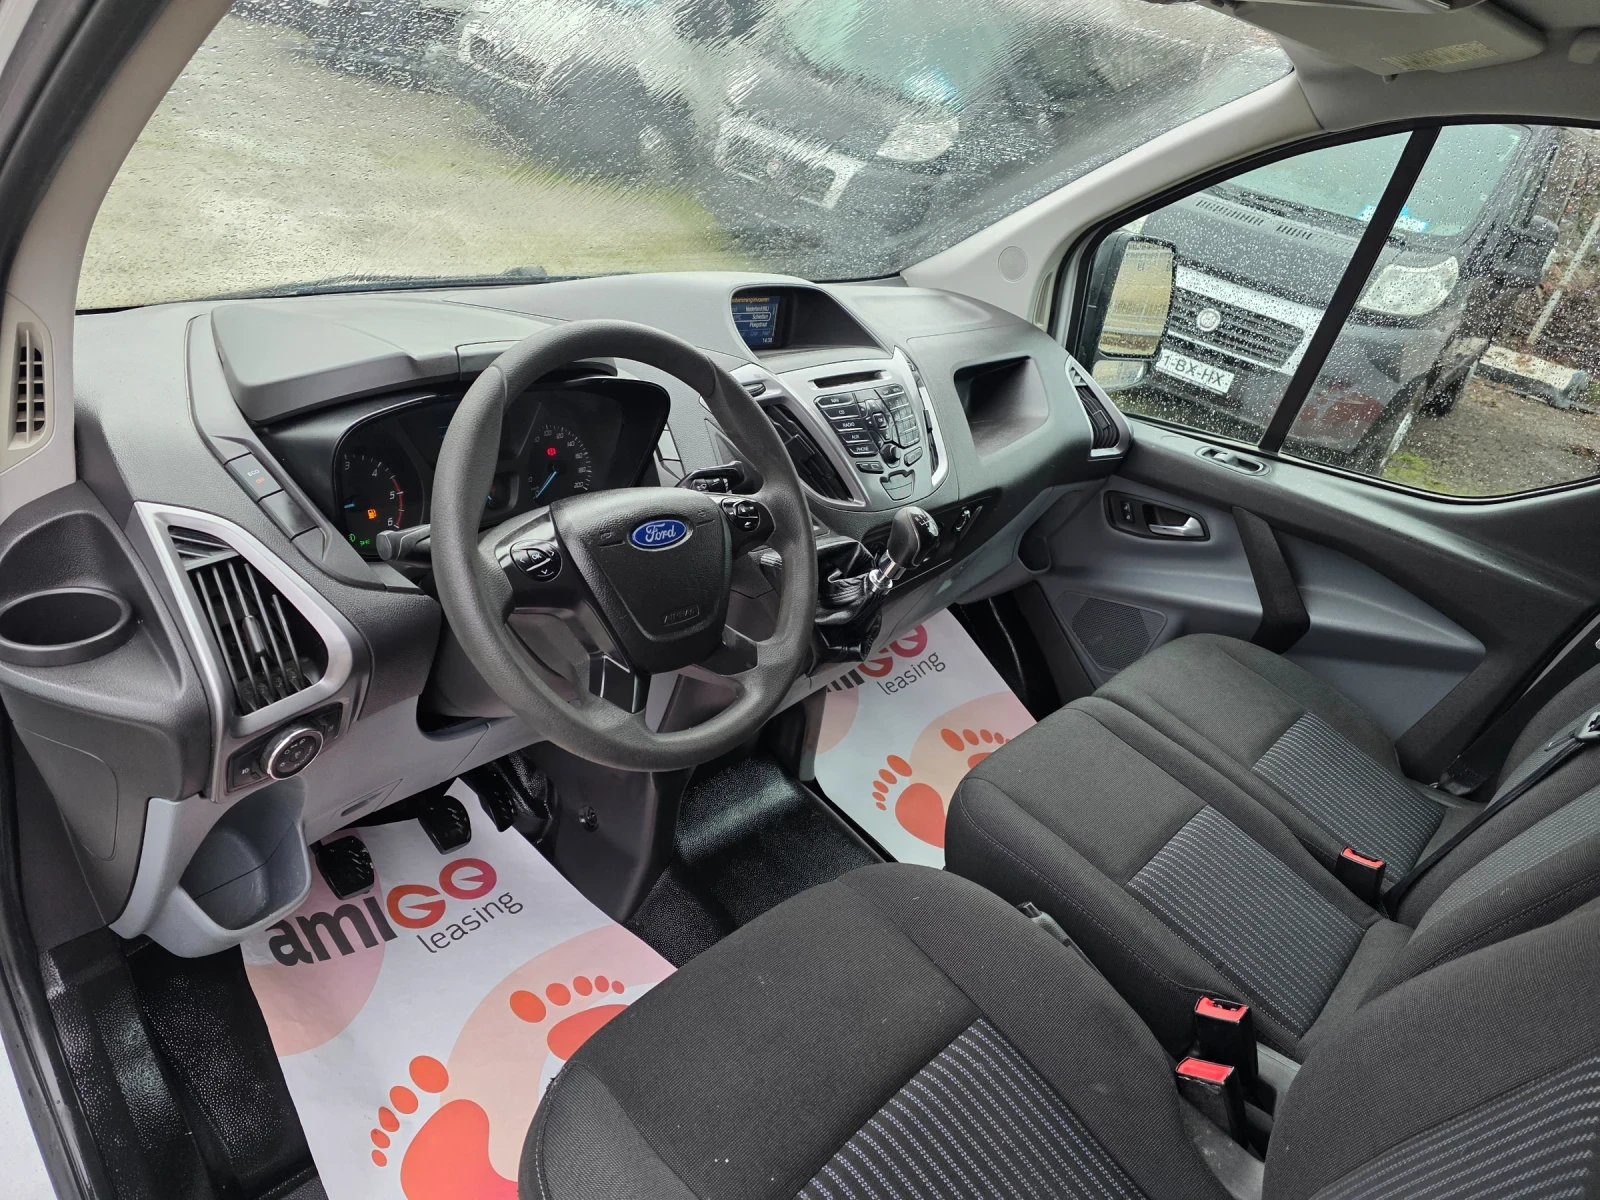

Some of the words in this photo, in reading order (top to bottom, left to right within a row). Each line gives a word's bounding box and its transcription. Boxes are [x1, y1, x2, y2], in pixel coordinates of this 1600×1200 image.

[247, 469, 260, 477] ECO
[645, 523, 677, 543] Ford
[876, 652, 946, 696] leasing
[416, 892, 524, 953] leasing
